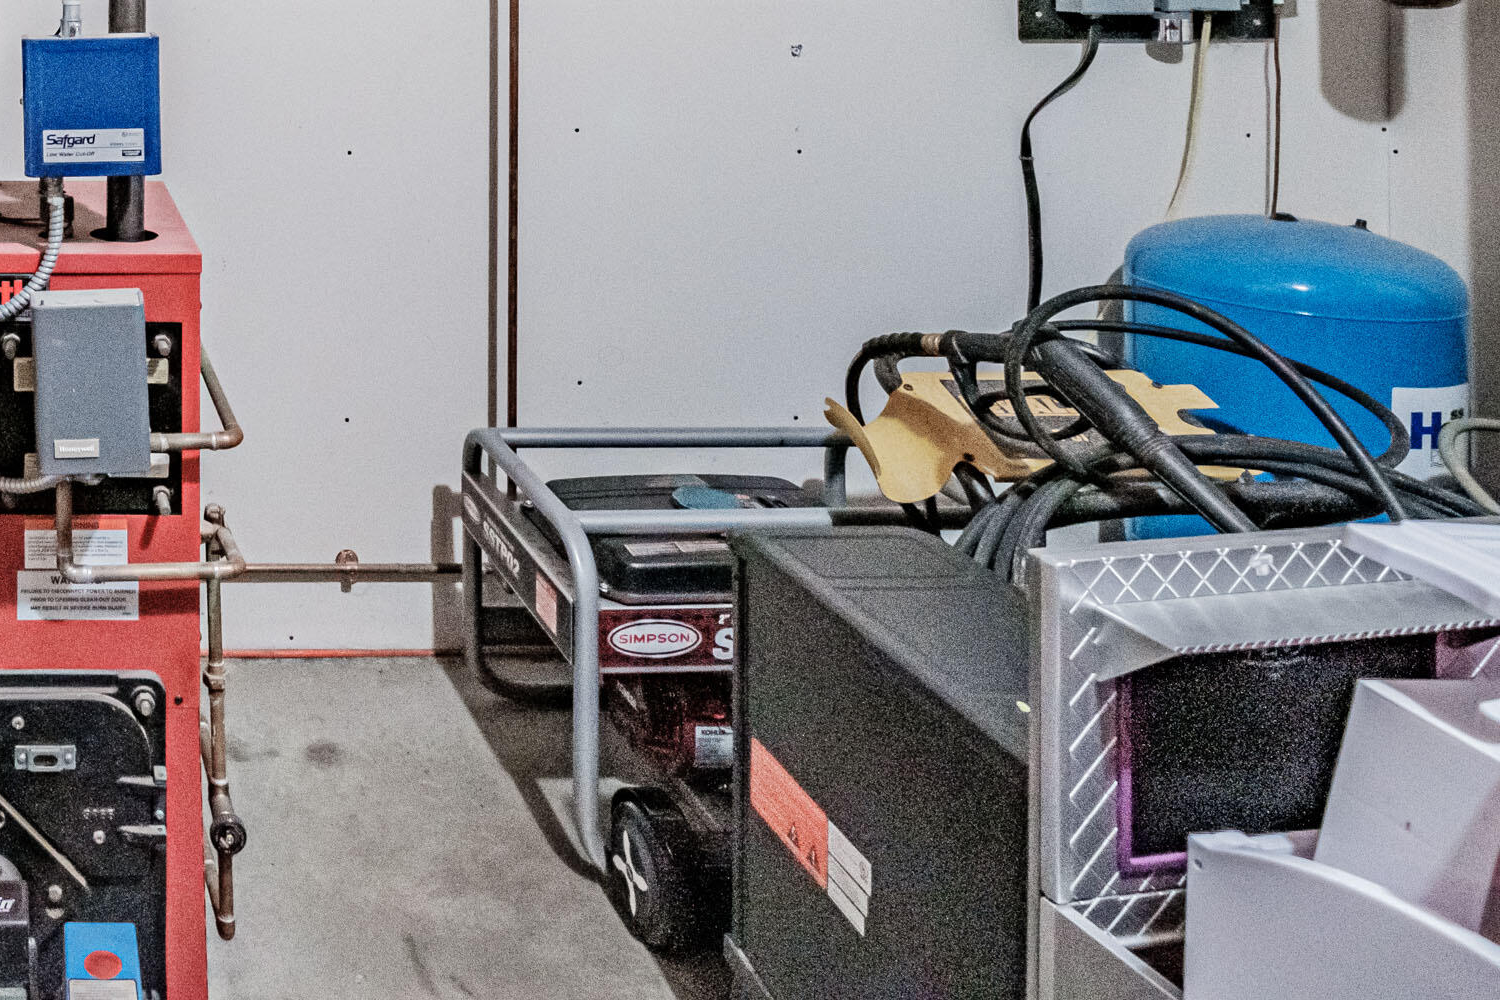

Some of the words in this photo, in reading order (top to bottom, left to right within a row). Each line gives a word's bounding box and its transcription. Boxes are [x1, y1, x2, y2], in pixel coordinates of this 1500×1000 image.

[45, 133, 96, 149] Safgard
[59, 445, 95, 454] Honeywell
[618, 633, 690, 644] SIMPSON
